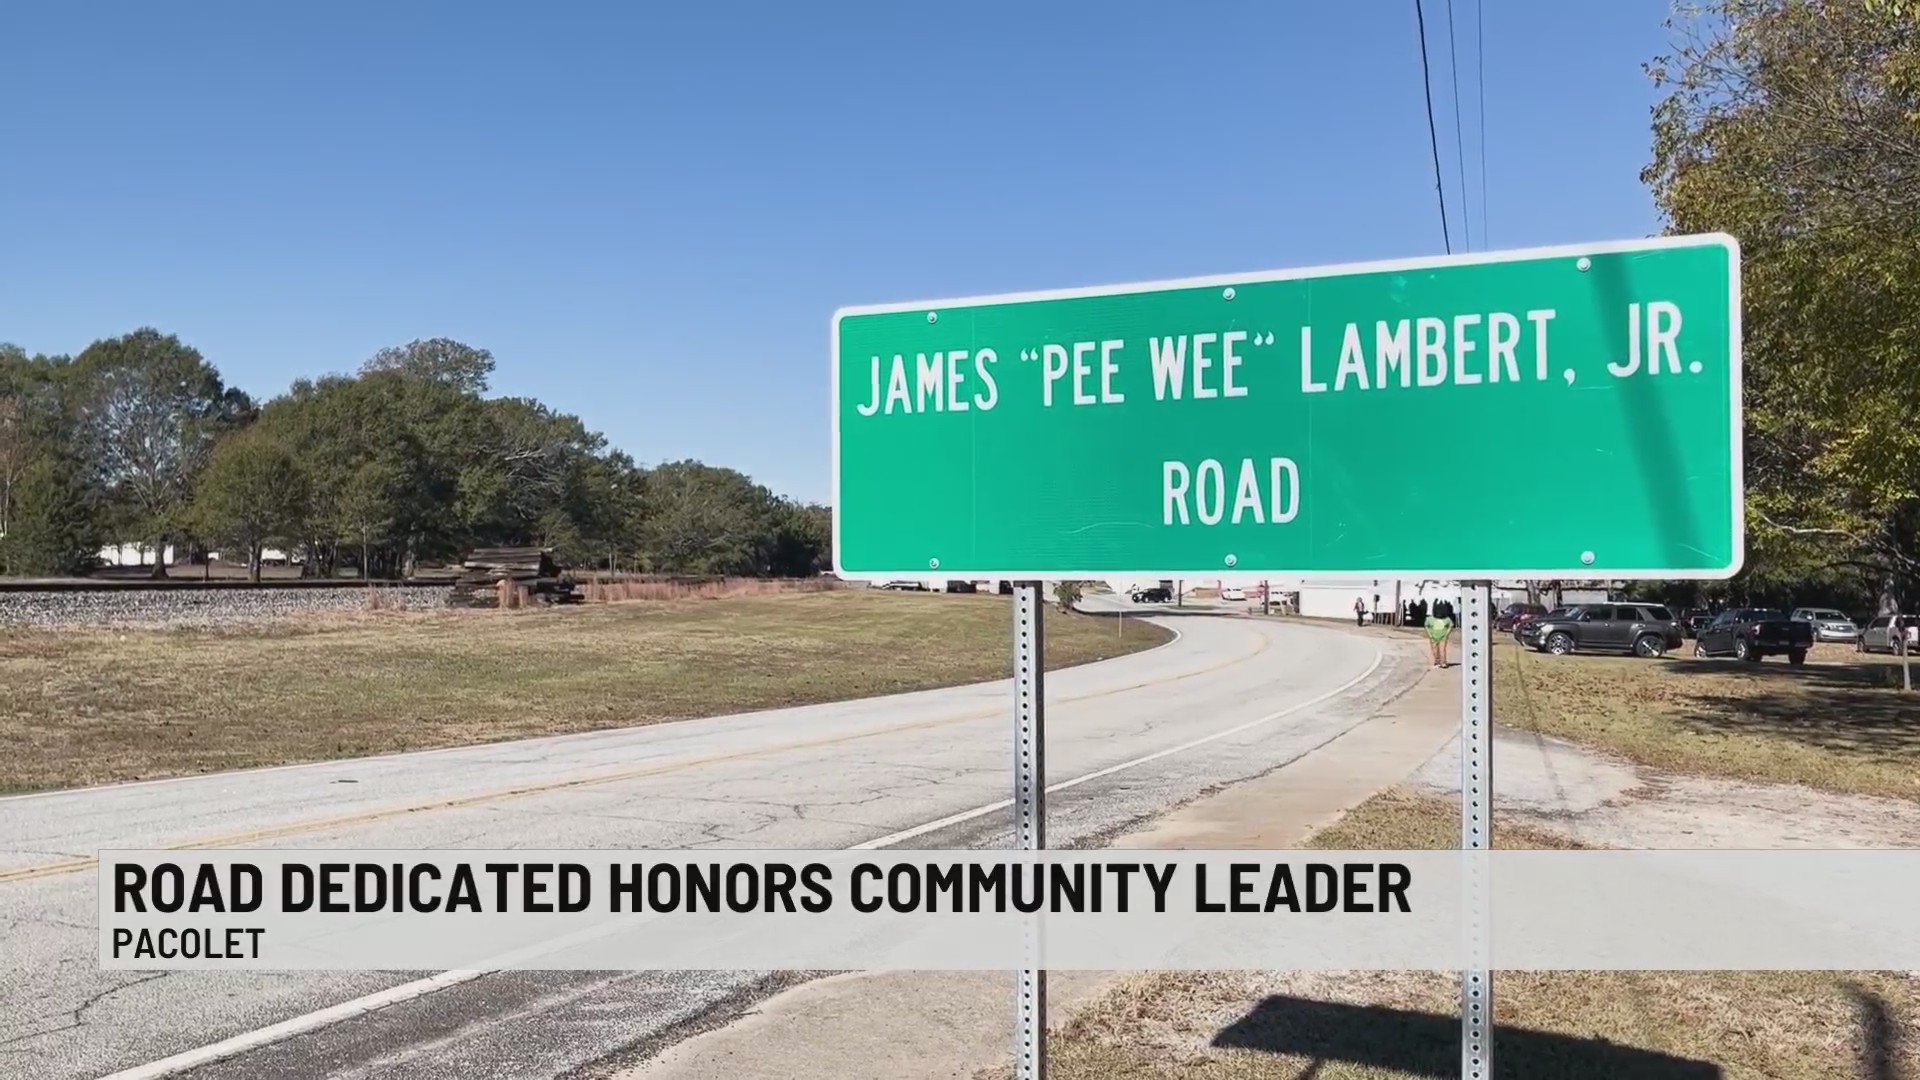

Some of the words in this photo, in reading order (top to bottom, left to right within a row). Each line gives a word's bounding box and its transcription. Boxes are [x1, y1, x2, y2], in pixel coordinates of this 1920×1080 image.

[857, 348, 999, 417] JAMES
[1300, 309, 1576, 394] LAMBERT,
[1607, 301, 1703, 378] JR.
[1162, 457, 1300, 526] ROAD
